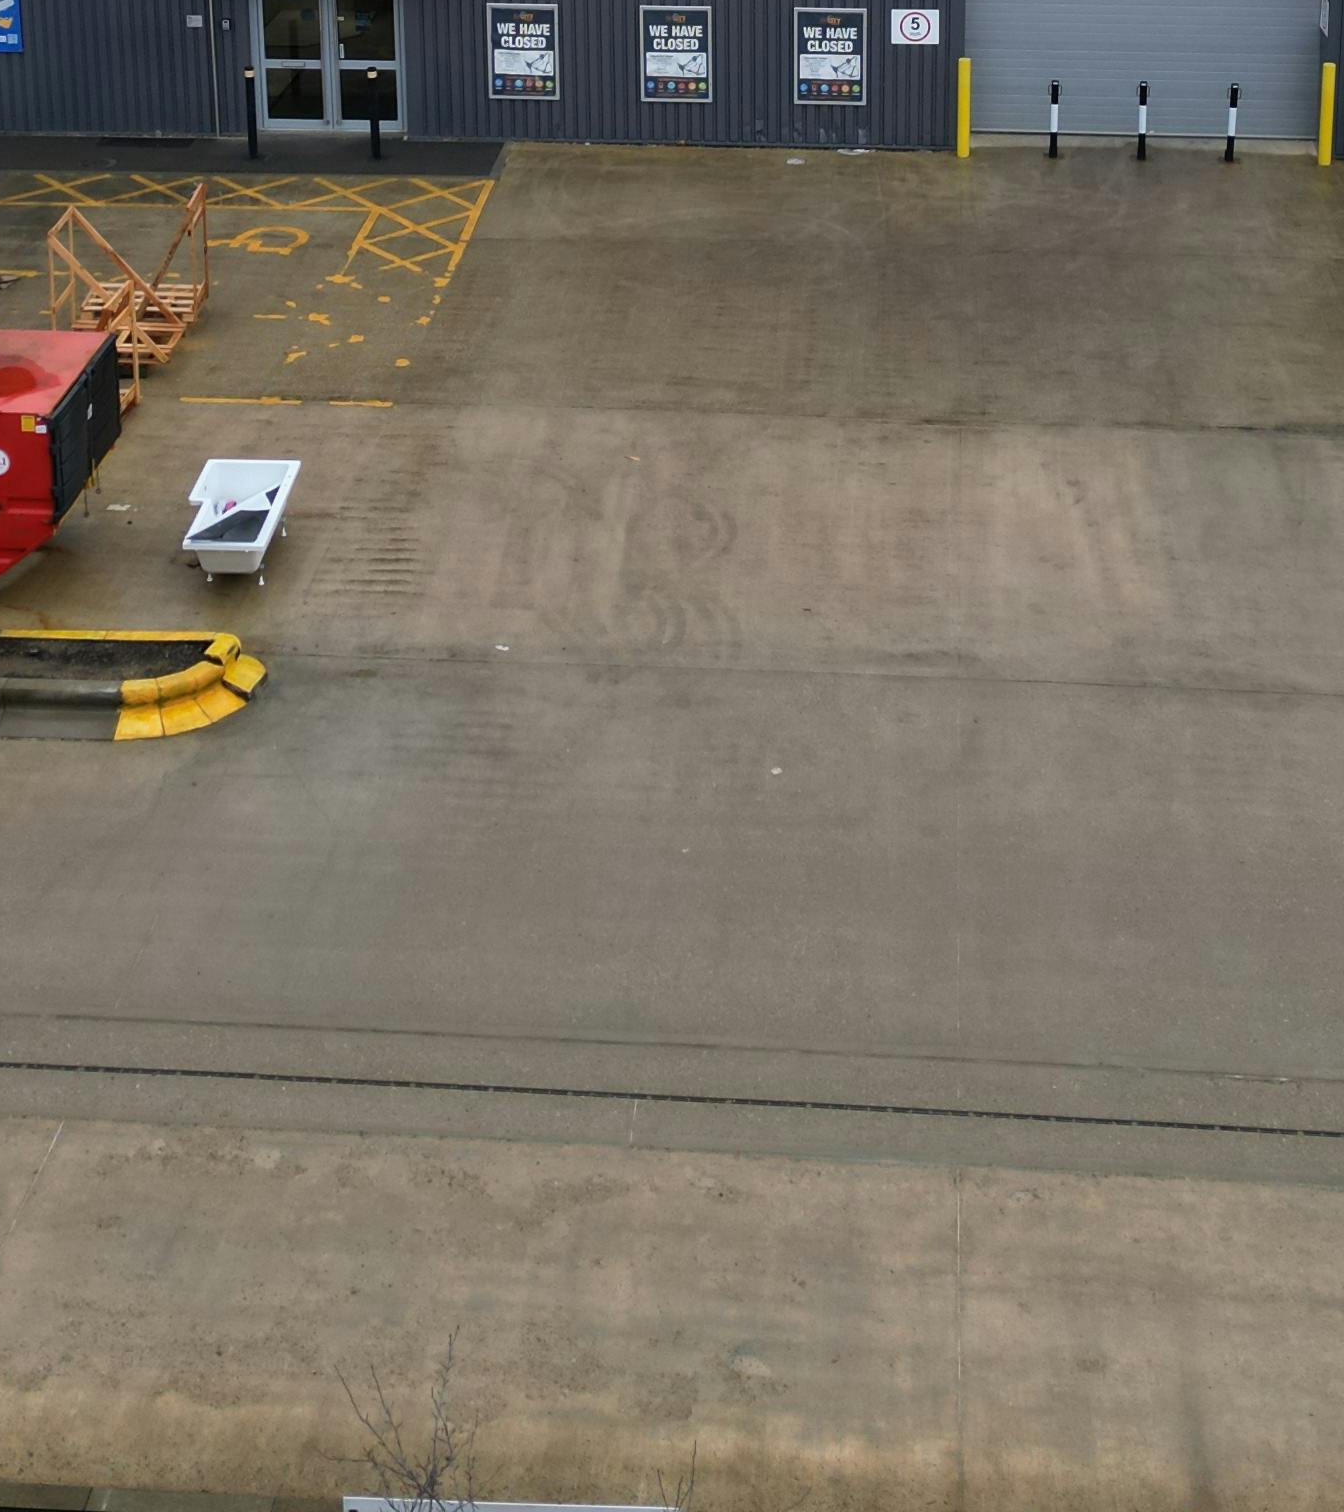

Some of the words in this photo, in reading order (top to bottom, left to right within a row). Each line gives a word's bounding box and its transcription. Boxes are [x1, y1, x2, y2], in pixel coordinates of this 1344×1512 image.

[497, 23, 516, 35] WE
[519, 23, 551, 35] HAVE
[910, 17, 920, 30] 5
[649, 25, 668, 37] WE
[672, 25, 703, 37] HAVE
[803, 27, 822, 38] WE
[826, 27, 858, 39] HAVE
[501, 36, 546, 48] CLOSED
[653, 38, 699, 50] CLOSED
[807, 40, 853, 52] CLOSED
